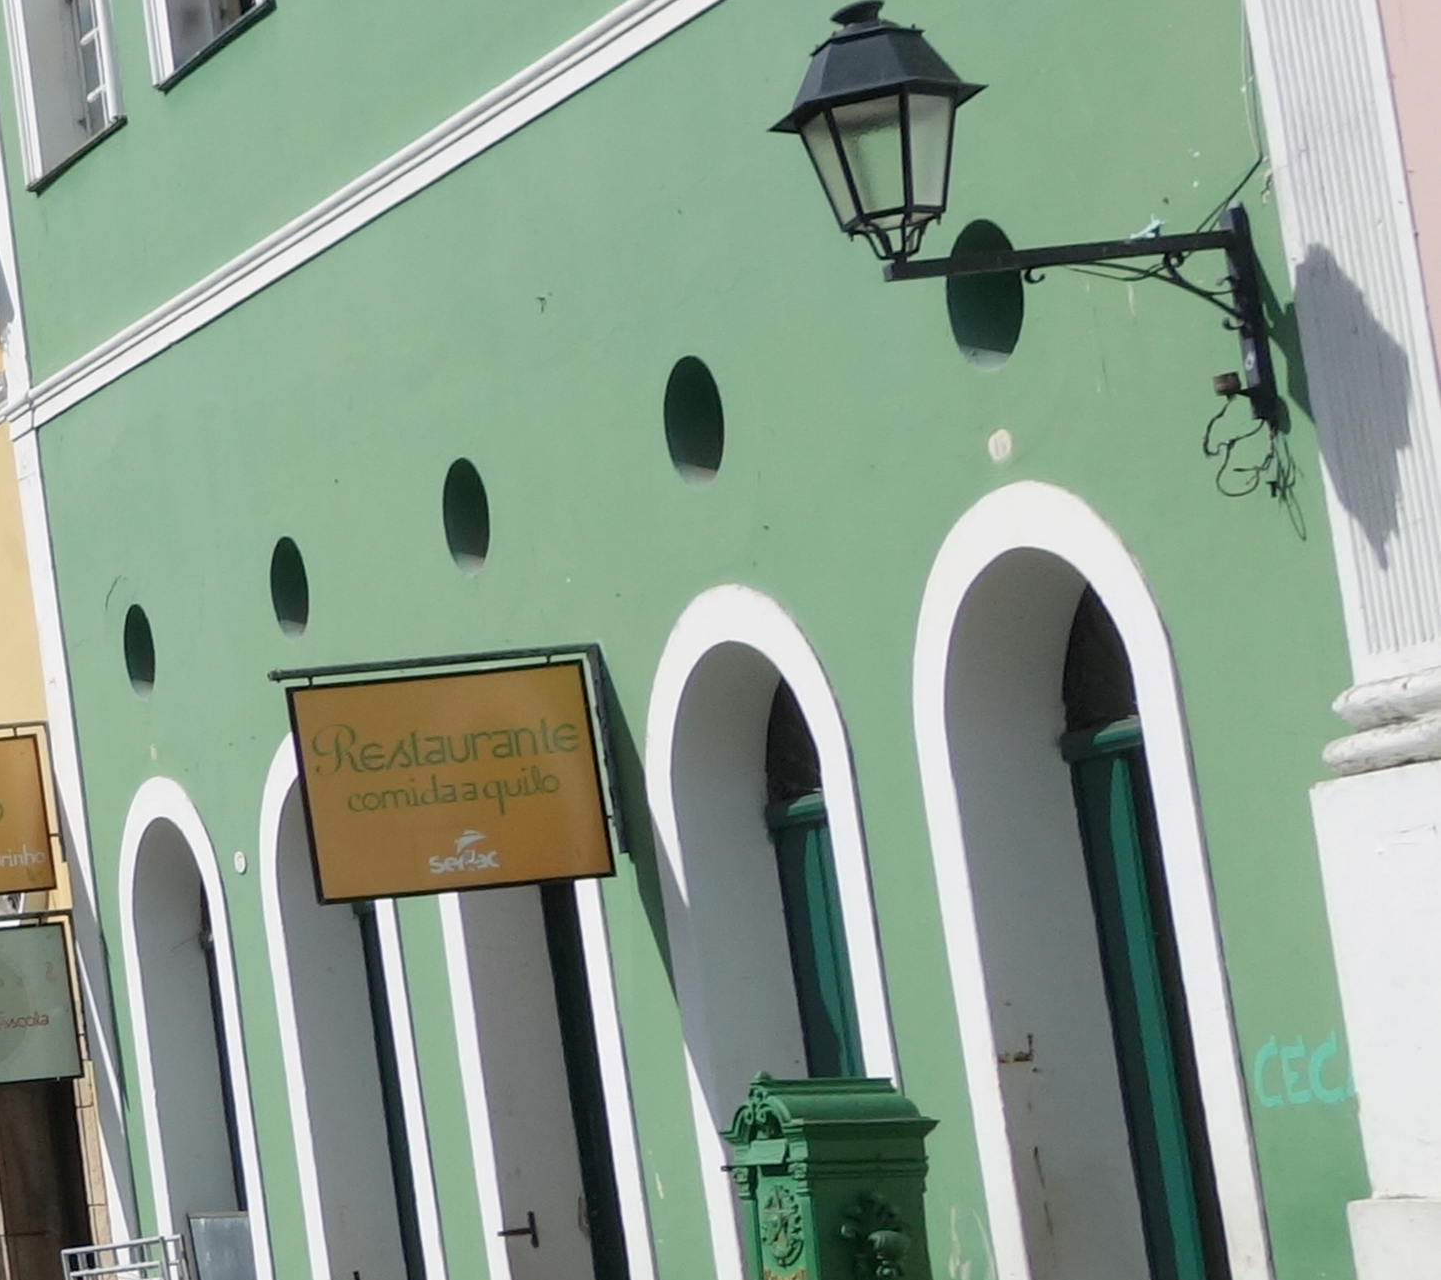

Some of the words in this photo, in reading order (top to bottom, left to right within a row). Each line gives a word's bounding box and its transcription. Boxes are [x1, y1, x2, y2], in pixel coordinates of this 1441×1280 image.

[310, 718, 579, 776] Restaurante
[347, 773, 456, 813] comida
[482, 765, 560, 816] quilo
